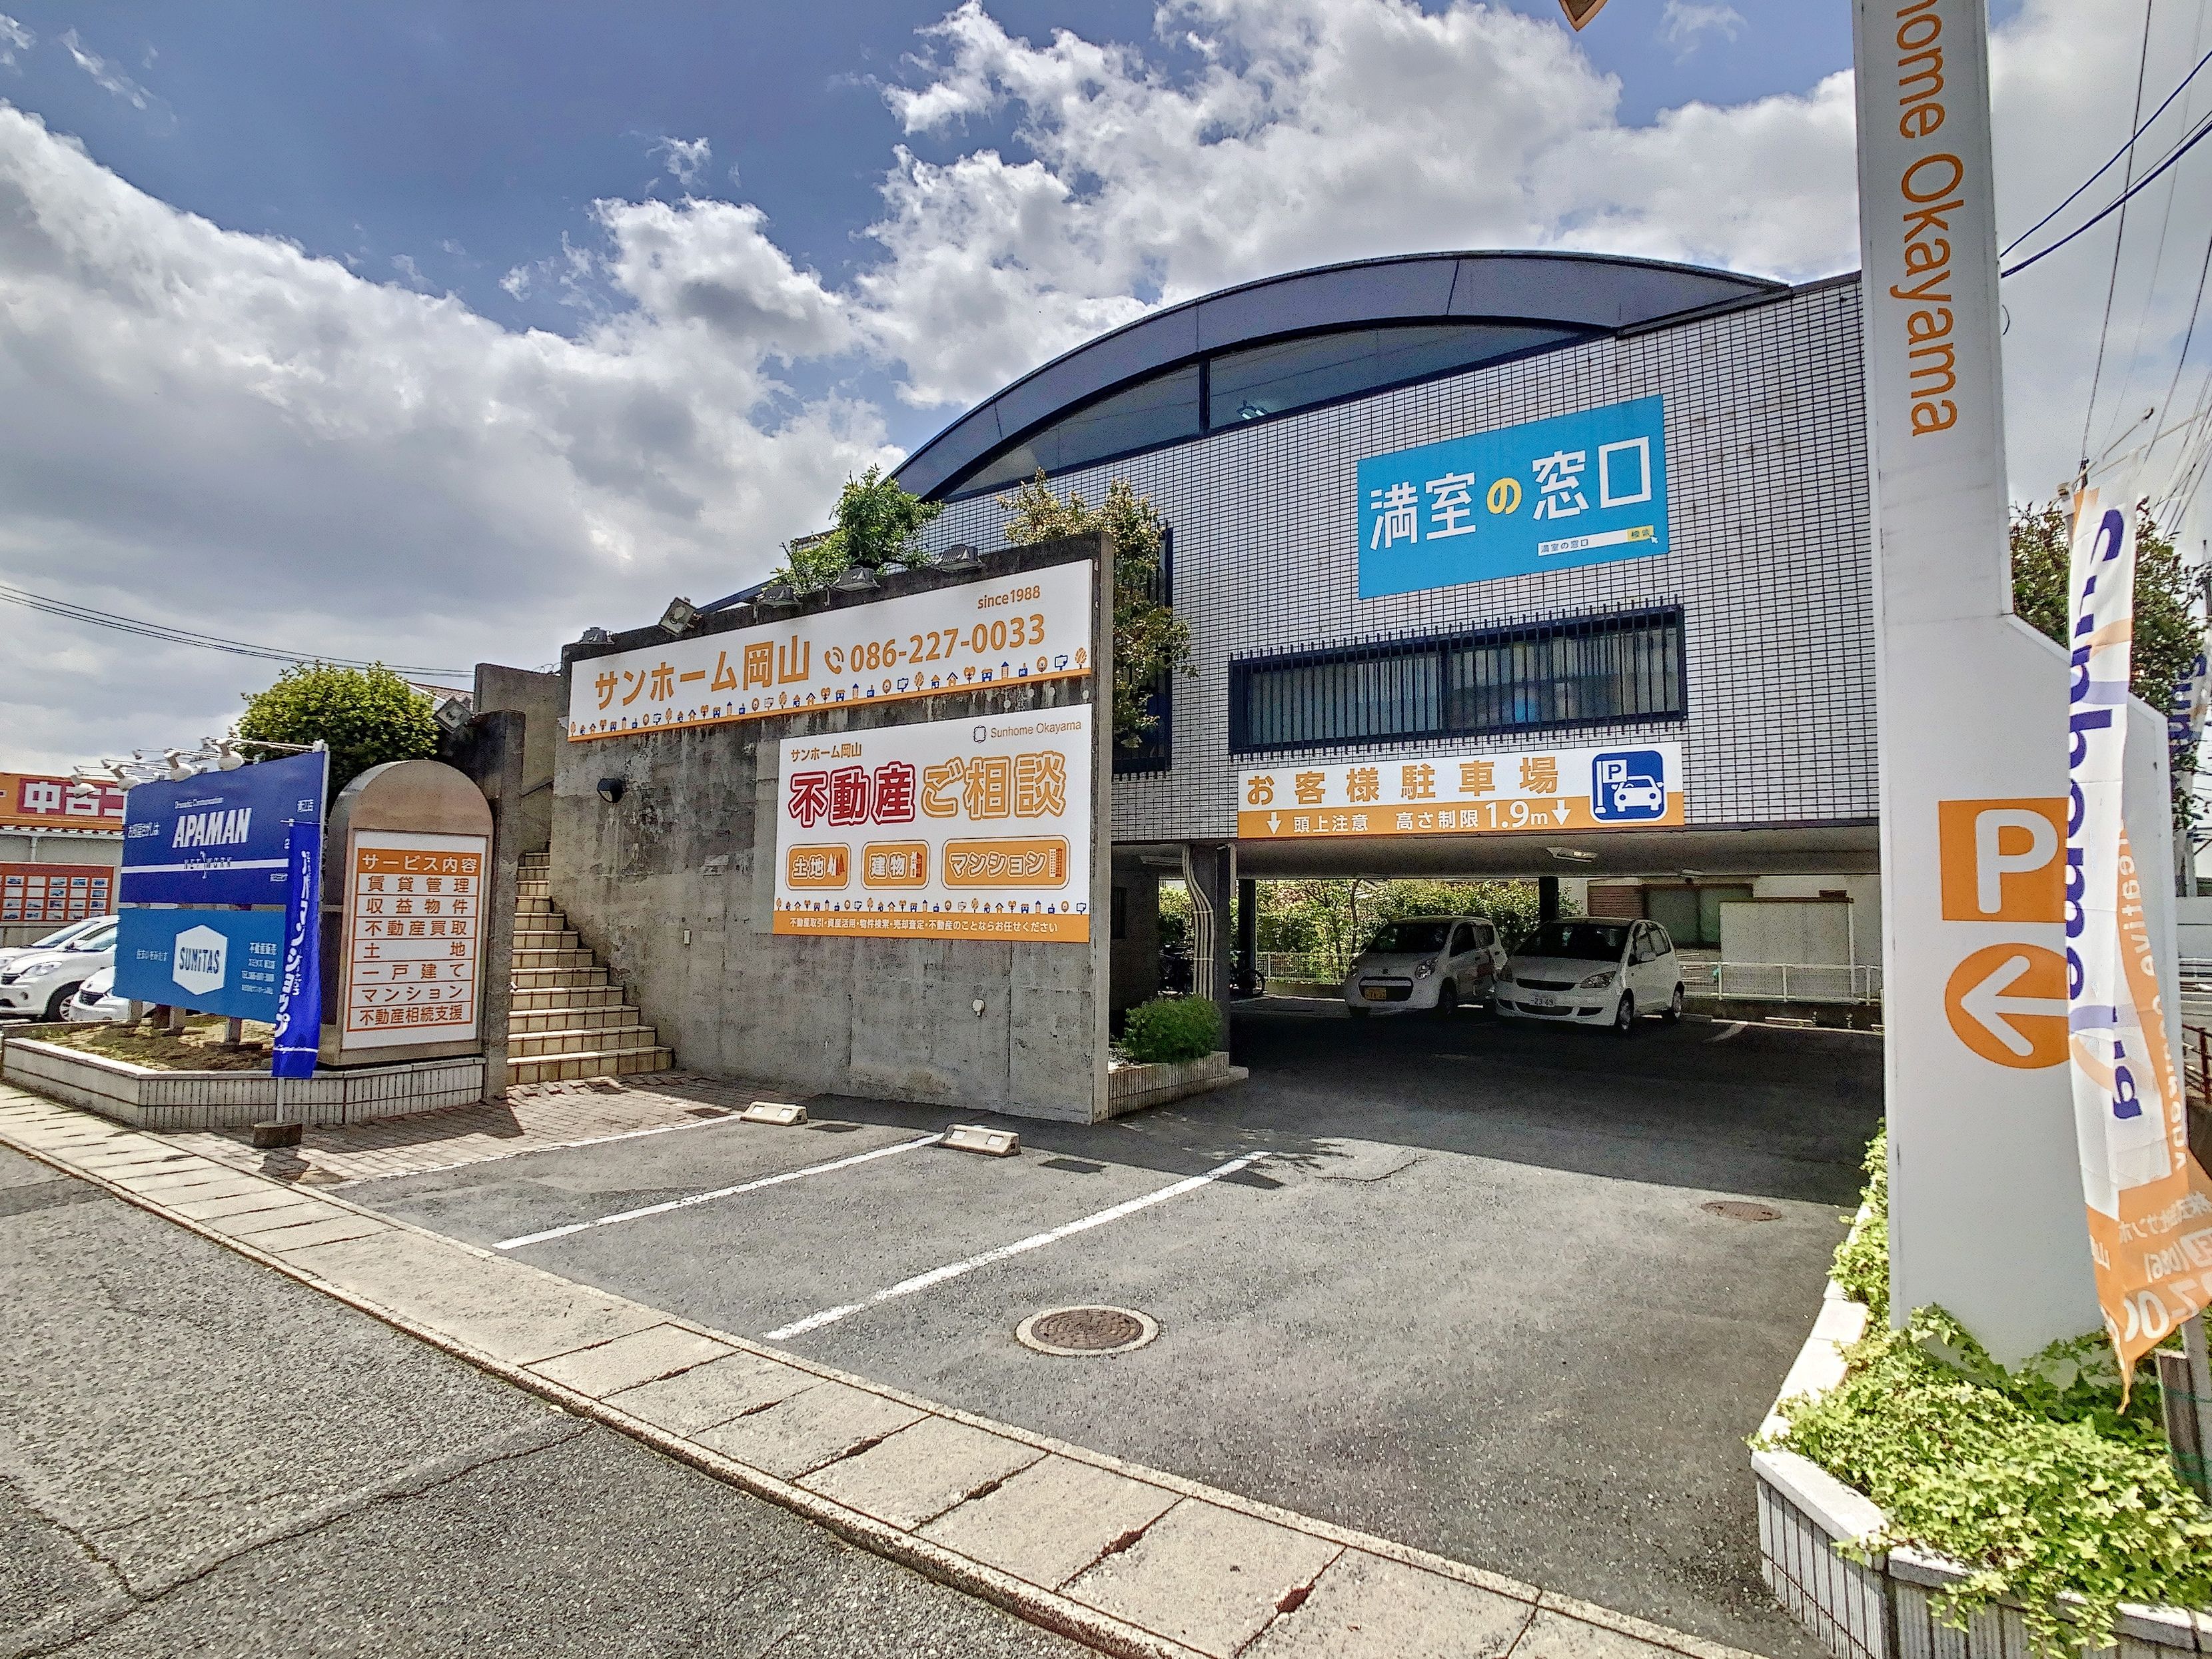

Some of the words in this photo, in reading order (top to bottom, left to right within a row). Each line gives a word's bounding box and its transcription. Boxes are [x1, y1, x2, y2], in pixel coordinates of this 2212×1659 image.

[1896, 0, 1947, 139] ome
[1890, 153, 1964, 437] Okayama
[1370, 436, 1652, 550] 満室の窓口
[1540, 538, 1588, 553] 満室の窓口
[977, 584, 1041, 611] since1988
[594, 634, 812, 711] サンホーム岡山
[849, 614, 1046, 672] 086-227-0033
[990, 725, 1033, 738] Sunhome
[1036, 719, 1082, 737] Okayama
[791, 742, 862, 762] サンホーム岡山
[788, 750, 1067, 828] 不動産ご相談
[1247, 756, 1559, 806] お客様駐車場
[172, 808, 252, 848] APAMAN
[1293, 814, 1369, 833] 頭上注意
[362, 854, 477, 873] サービス内容
[792, 853, 828, 880] 土地
[869, 851, 906, 880] 建物
[948, 851, 1046, 879] マンション
[1975, 808, 2059, 914] P
[368, 875, 469, 893] 賃貸管理
[366, 898, 468, 914] 収益物件
[365, 920, 466, 936] 不動産買取
[364, 941, 465, 959] 土地
[362, 963, 465, 980] 一戸建て
[362, 985, 463, 1002] マンション
[360, 1005, 463, 1026] 不動産相続支援
